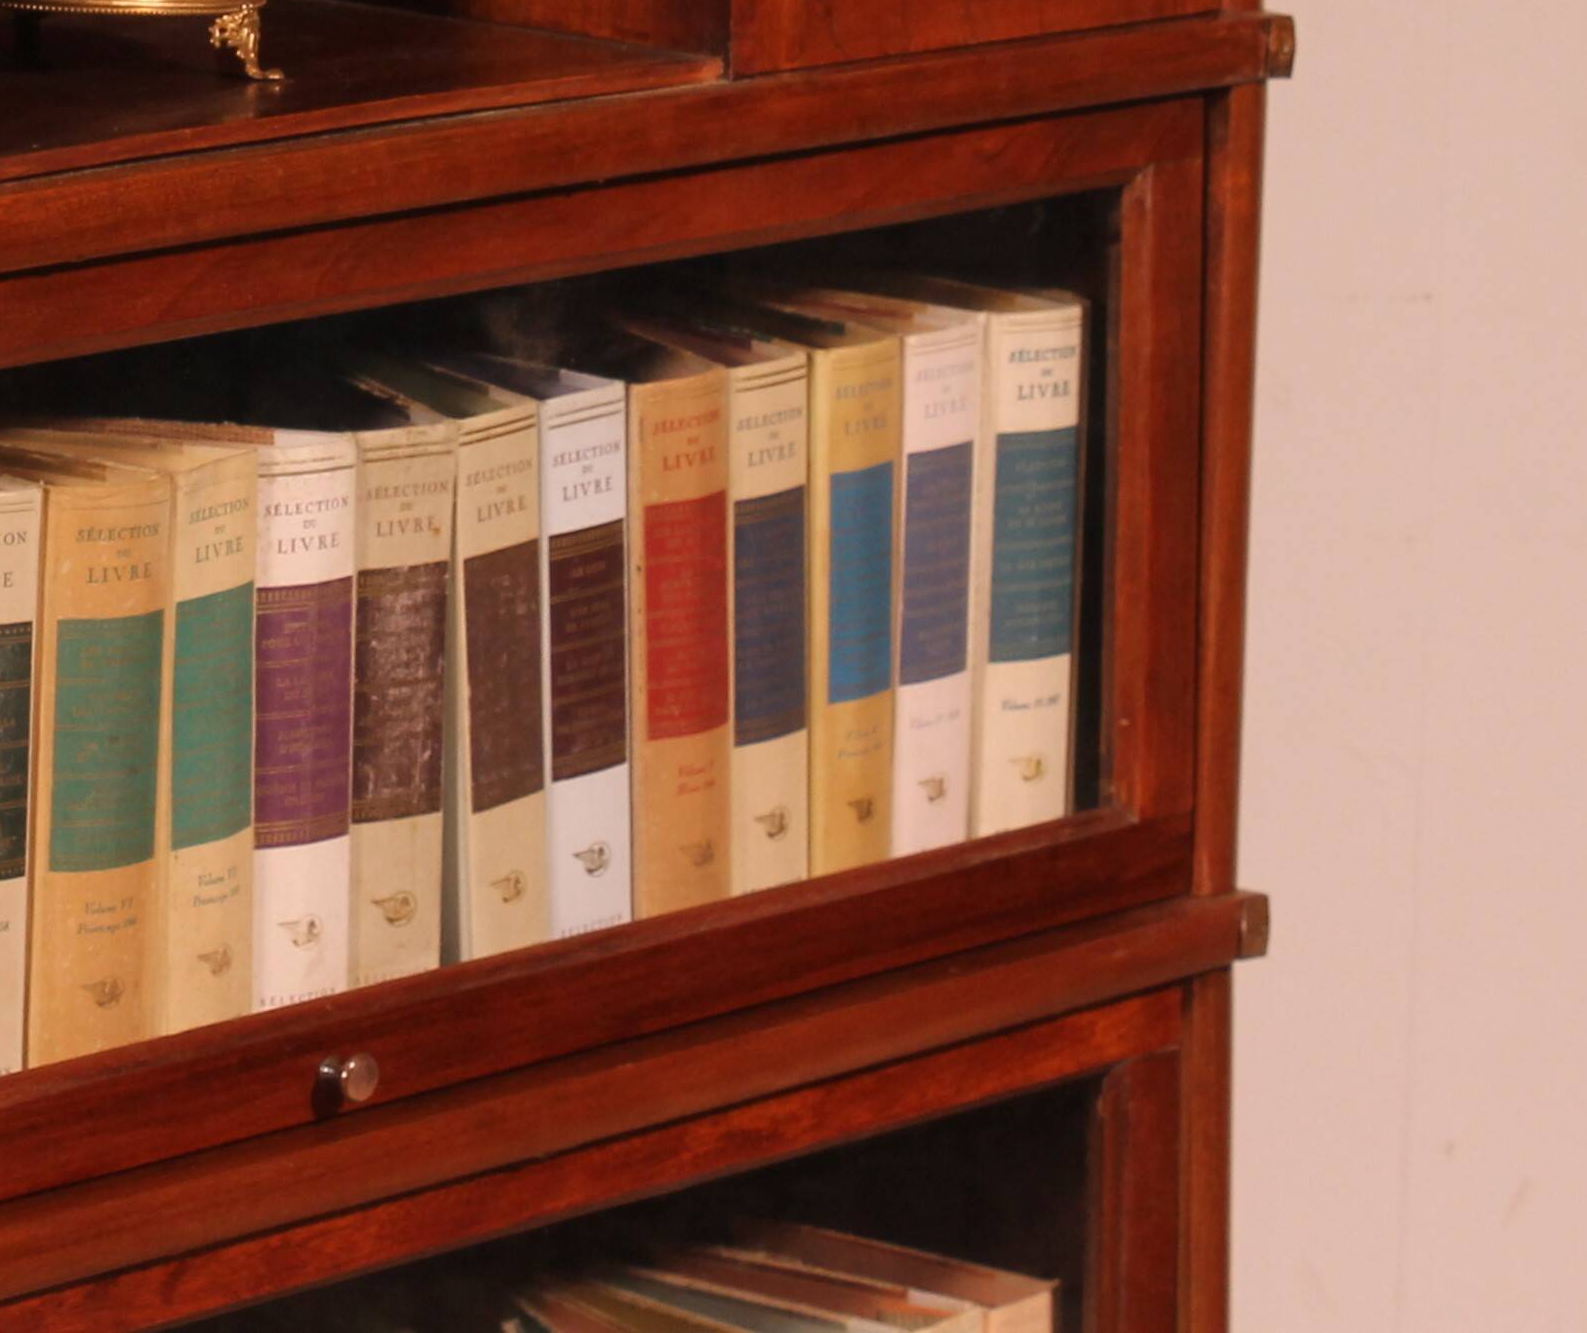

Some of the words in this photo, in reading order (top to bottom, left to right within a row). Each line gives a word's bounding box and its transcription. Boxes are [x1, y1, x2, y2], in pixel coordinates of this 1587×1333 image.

[1017, 381, 1070, 402] LIVRE
[663, 446, 717, 472] LIVRE
[747, 441, 798, 468] LIVRE
[562, 476, 614, 503] LIVRE
[264, 495, 350, 518] SÉLECTION
[477, 495, 529, 523] LIVRE
[376, 516, 436, 538] LIVRE
[195, 537, 244, 564] LIVRE
[276, 532, 341, 556] LIVRE
[86, 561, 153, 585] LIVRE
